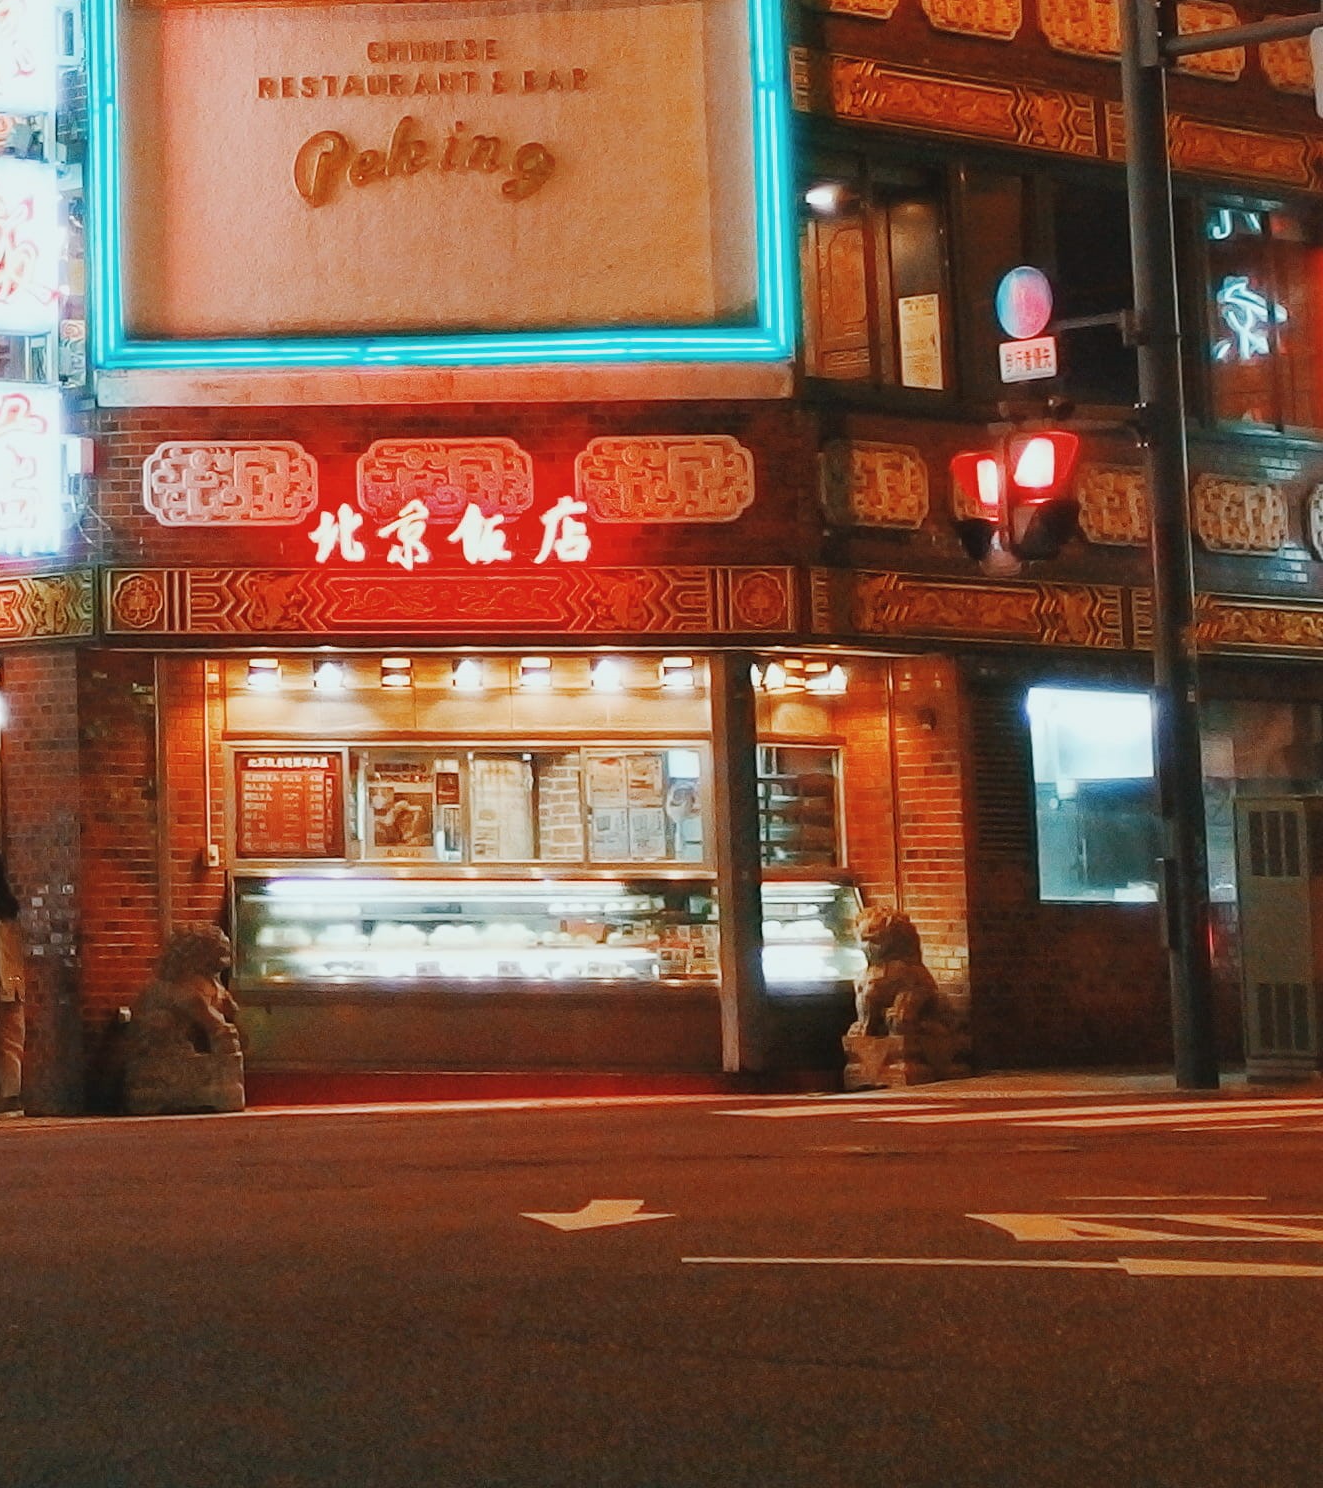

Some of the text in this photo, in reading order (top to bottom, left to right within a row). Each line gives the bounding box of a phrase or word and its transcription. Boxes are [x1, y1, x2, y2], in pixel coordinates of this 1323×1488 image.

[366, 39, 499, 64] CHINESE
[258, 71, 479, 99] RESTAURANT
[522, 68, 589, 94] BAR
[293, 116, 556, 208] Peking
[308, 496, 592, 571] 北京飯店
